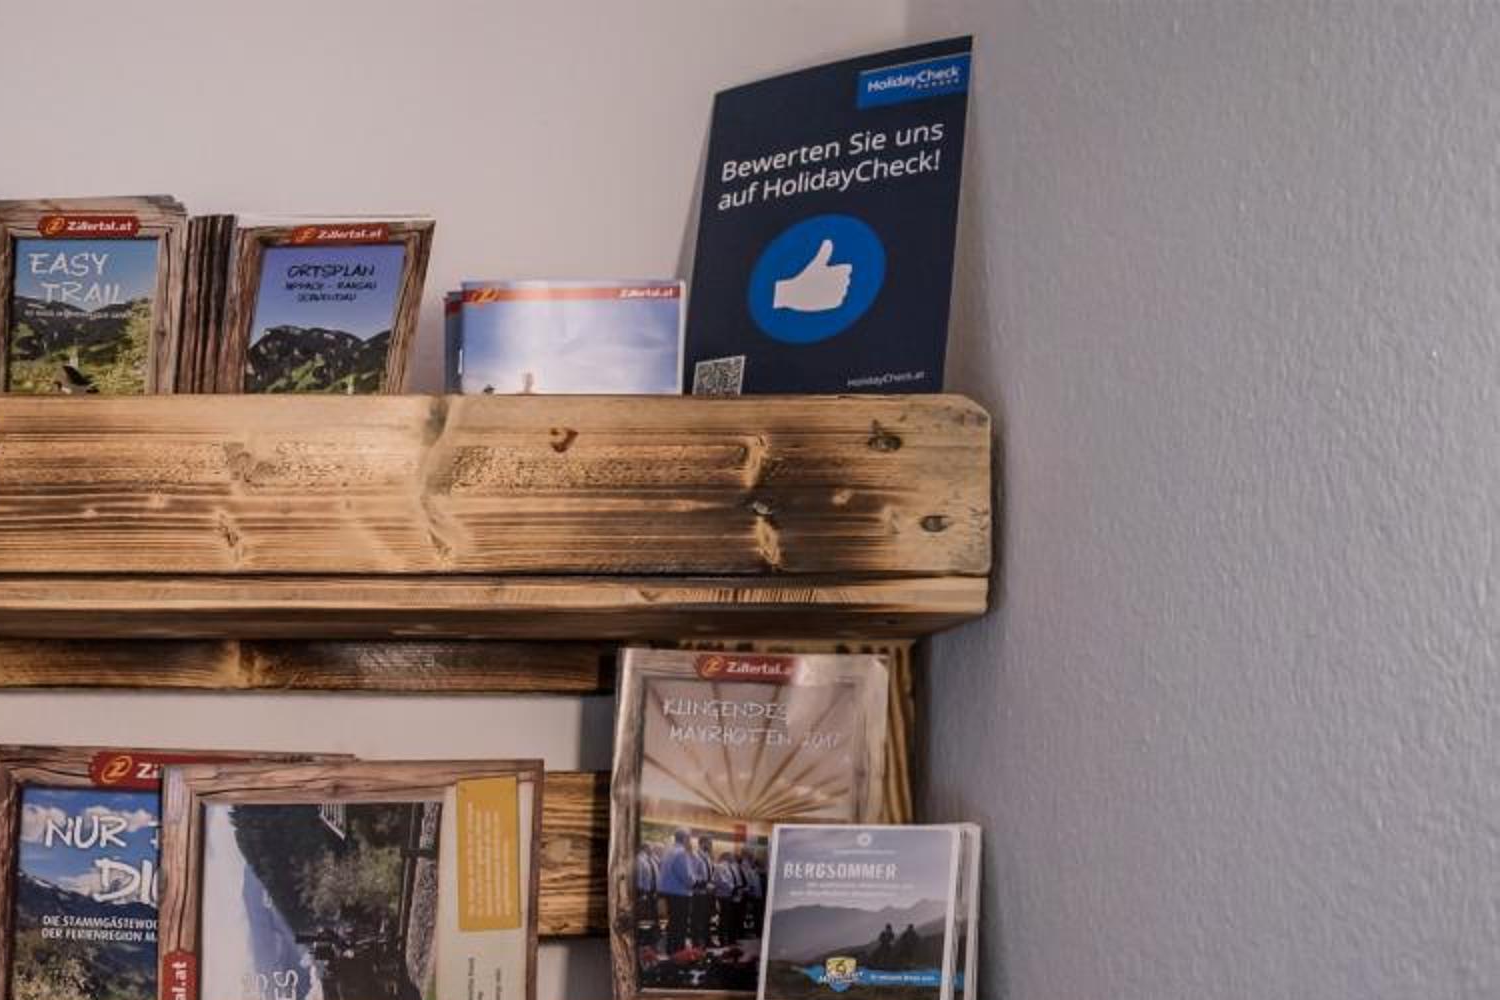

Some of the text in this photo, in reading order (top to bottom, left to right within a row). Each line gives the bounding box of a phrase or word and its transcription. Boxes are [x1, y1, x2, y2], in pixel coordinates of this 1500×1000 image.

[867, 65, 960, 93] HolidayCheck
[721, 123, 944, 182] Bewerten Sie uns
[717, 149, 941, 211] auf HolidayCheck!
[67, 221, 133, 232] Zillertal.at
[28, 252, 109, 277] EASY
[287, 263, 376, 278] ORTSPLAN
[41, 281, 126, 304] TRAIL
[663, 698, 788, 721] KLINGENDES
[45, 815, 127, 848] NUR
[783, 862, 899, 881] BERGSOMMER
[43, 915, 60, 926] DIE
[41, 928, 62, 938] DER
